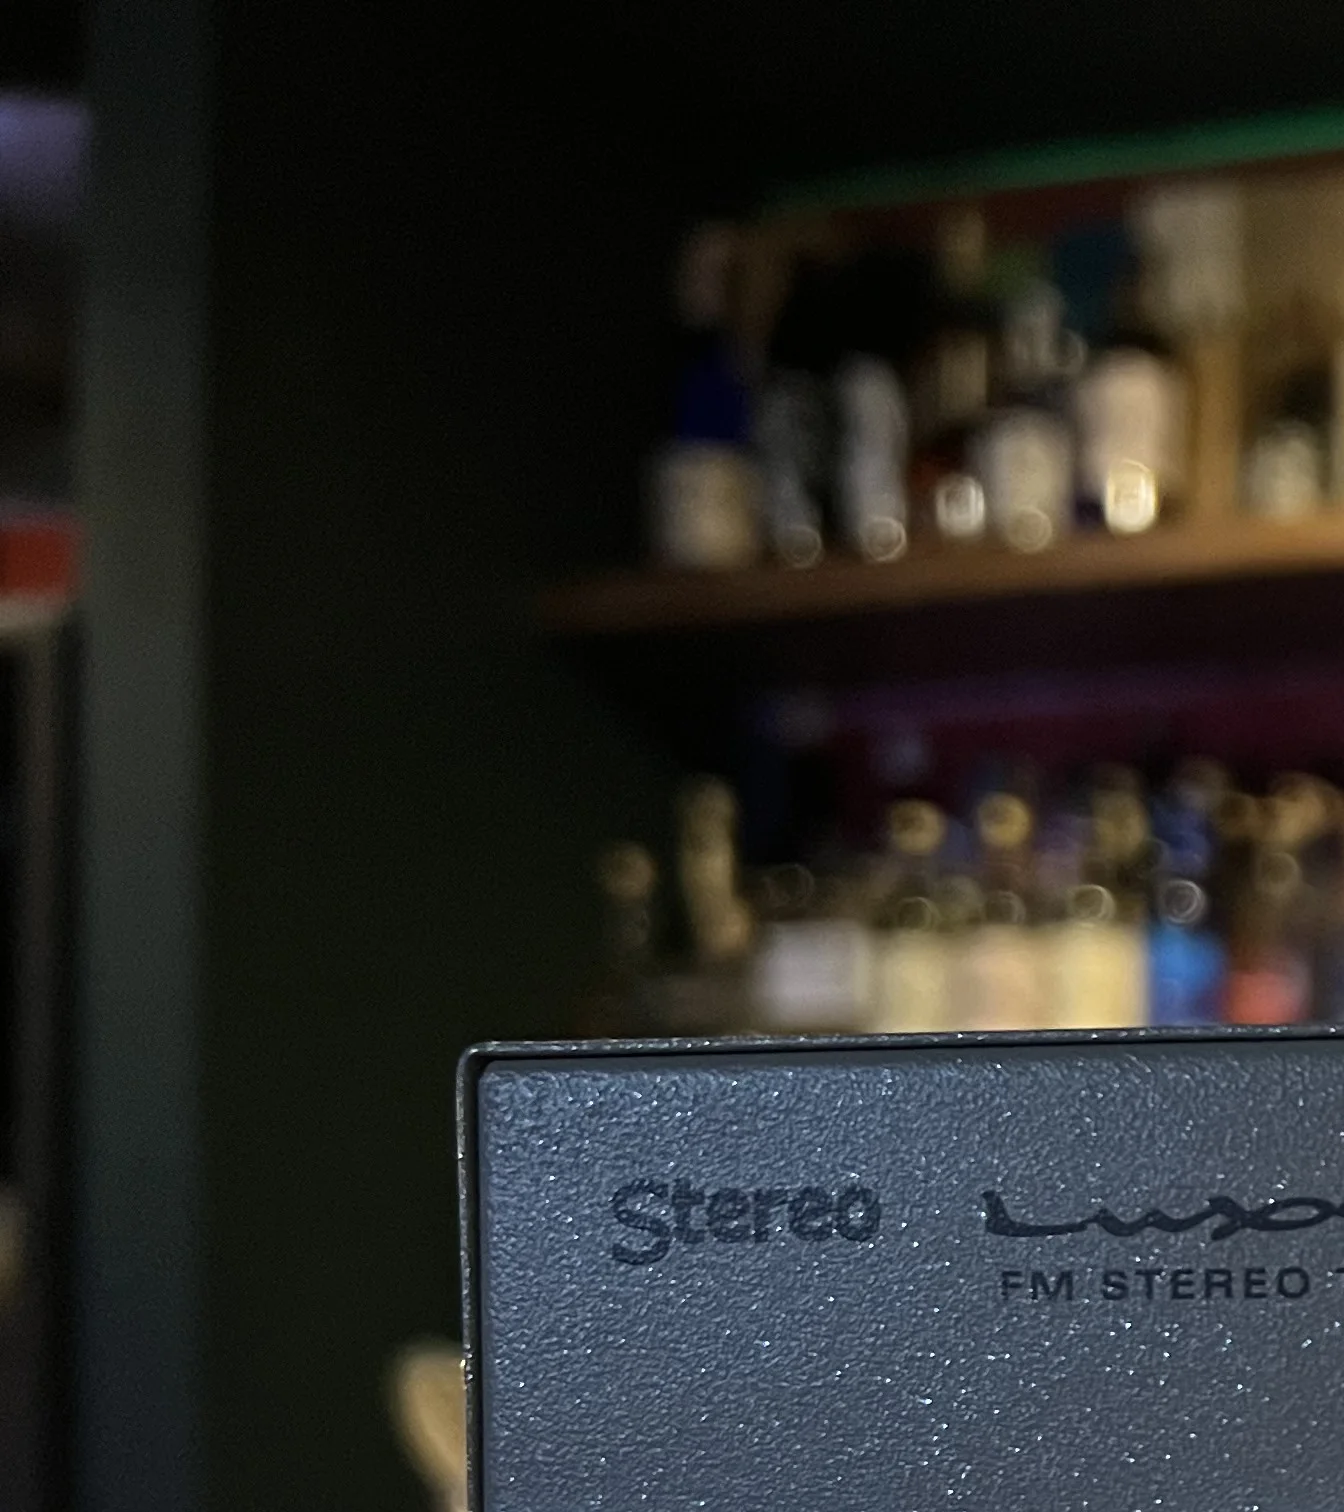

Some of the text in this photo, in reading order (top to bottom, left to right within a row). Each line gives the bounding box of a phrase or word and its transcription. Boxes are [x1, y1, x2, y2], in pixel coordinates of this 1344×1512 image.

[612, 1178, 880, 1264] Stereo
[1002, 1269, 1074, 1301] FM
[1102, 1268, 1311, 1301] STEREO
